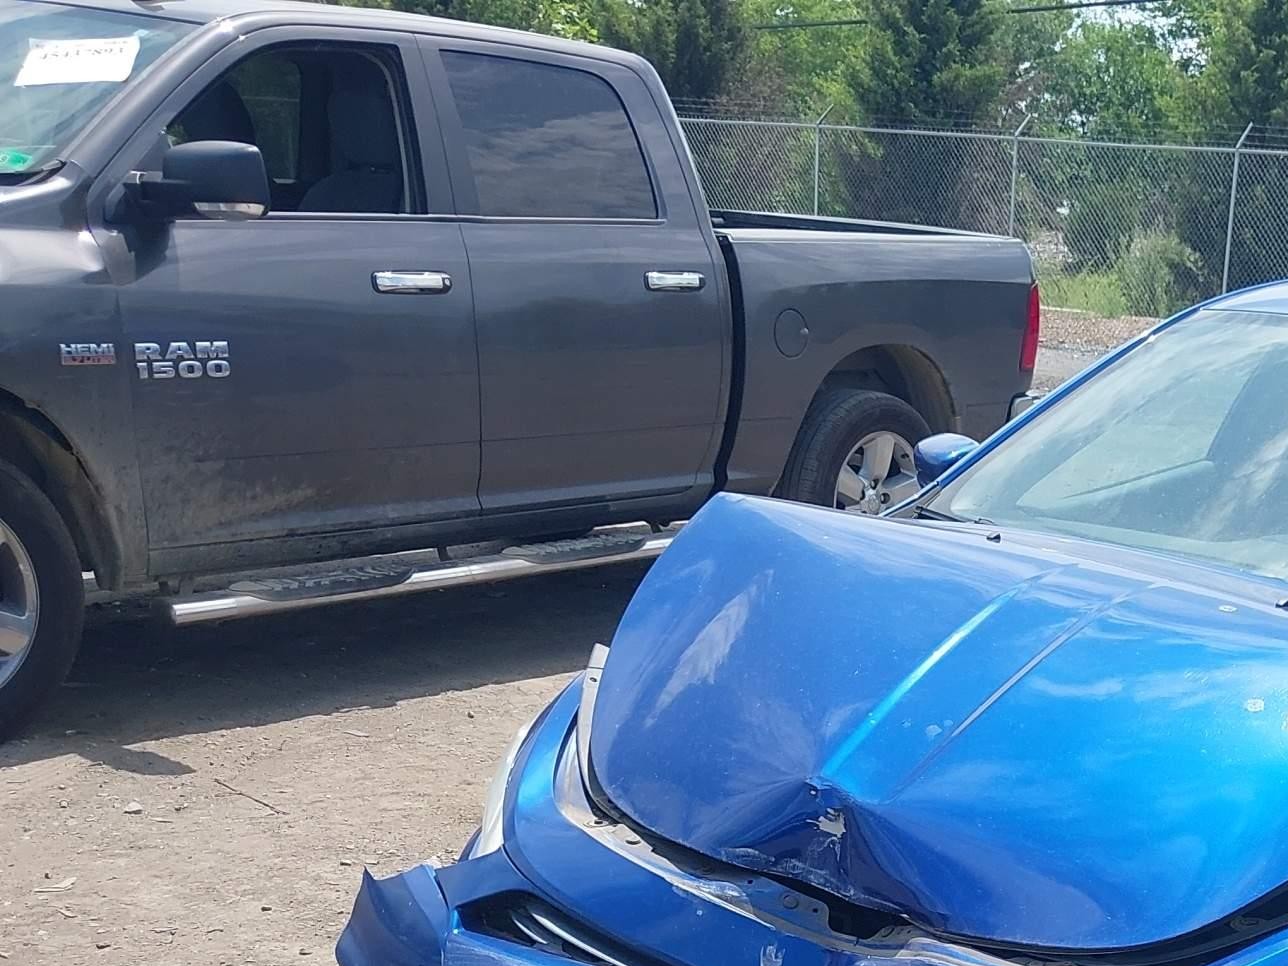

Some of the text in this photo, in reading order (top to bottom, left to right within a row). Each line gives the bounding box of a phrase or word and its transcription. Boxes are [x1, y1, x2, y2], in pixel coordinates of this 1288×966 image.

[59, 343, 115, 356] HEMI
[134, 341, 229, 359] RAM
[136, 360, 231, 379] 1500
